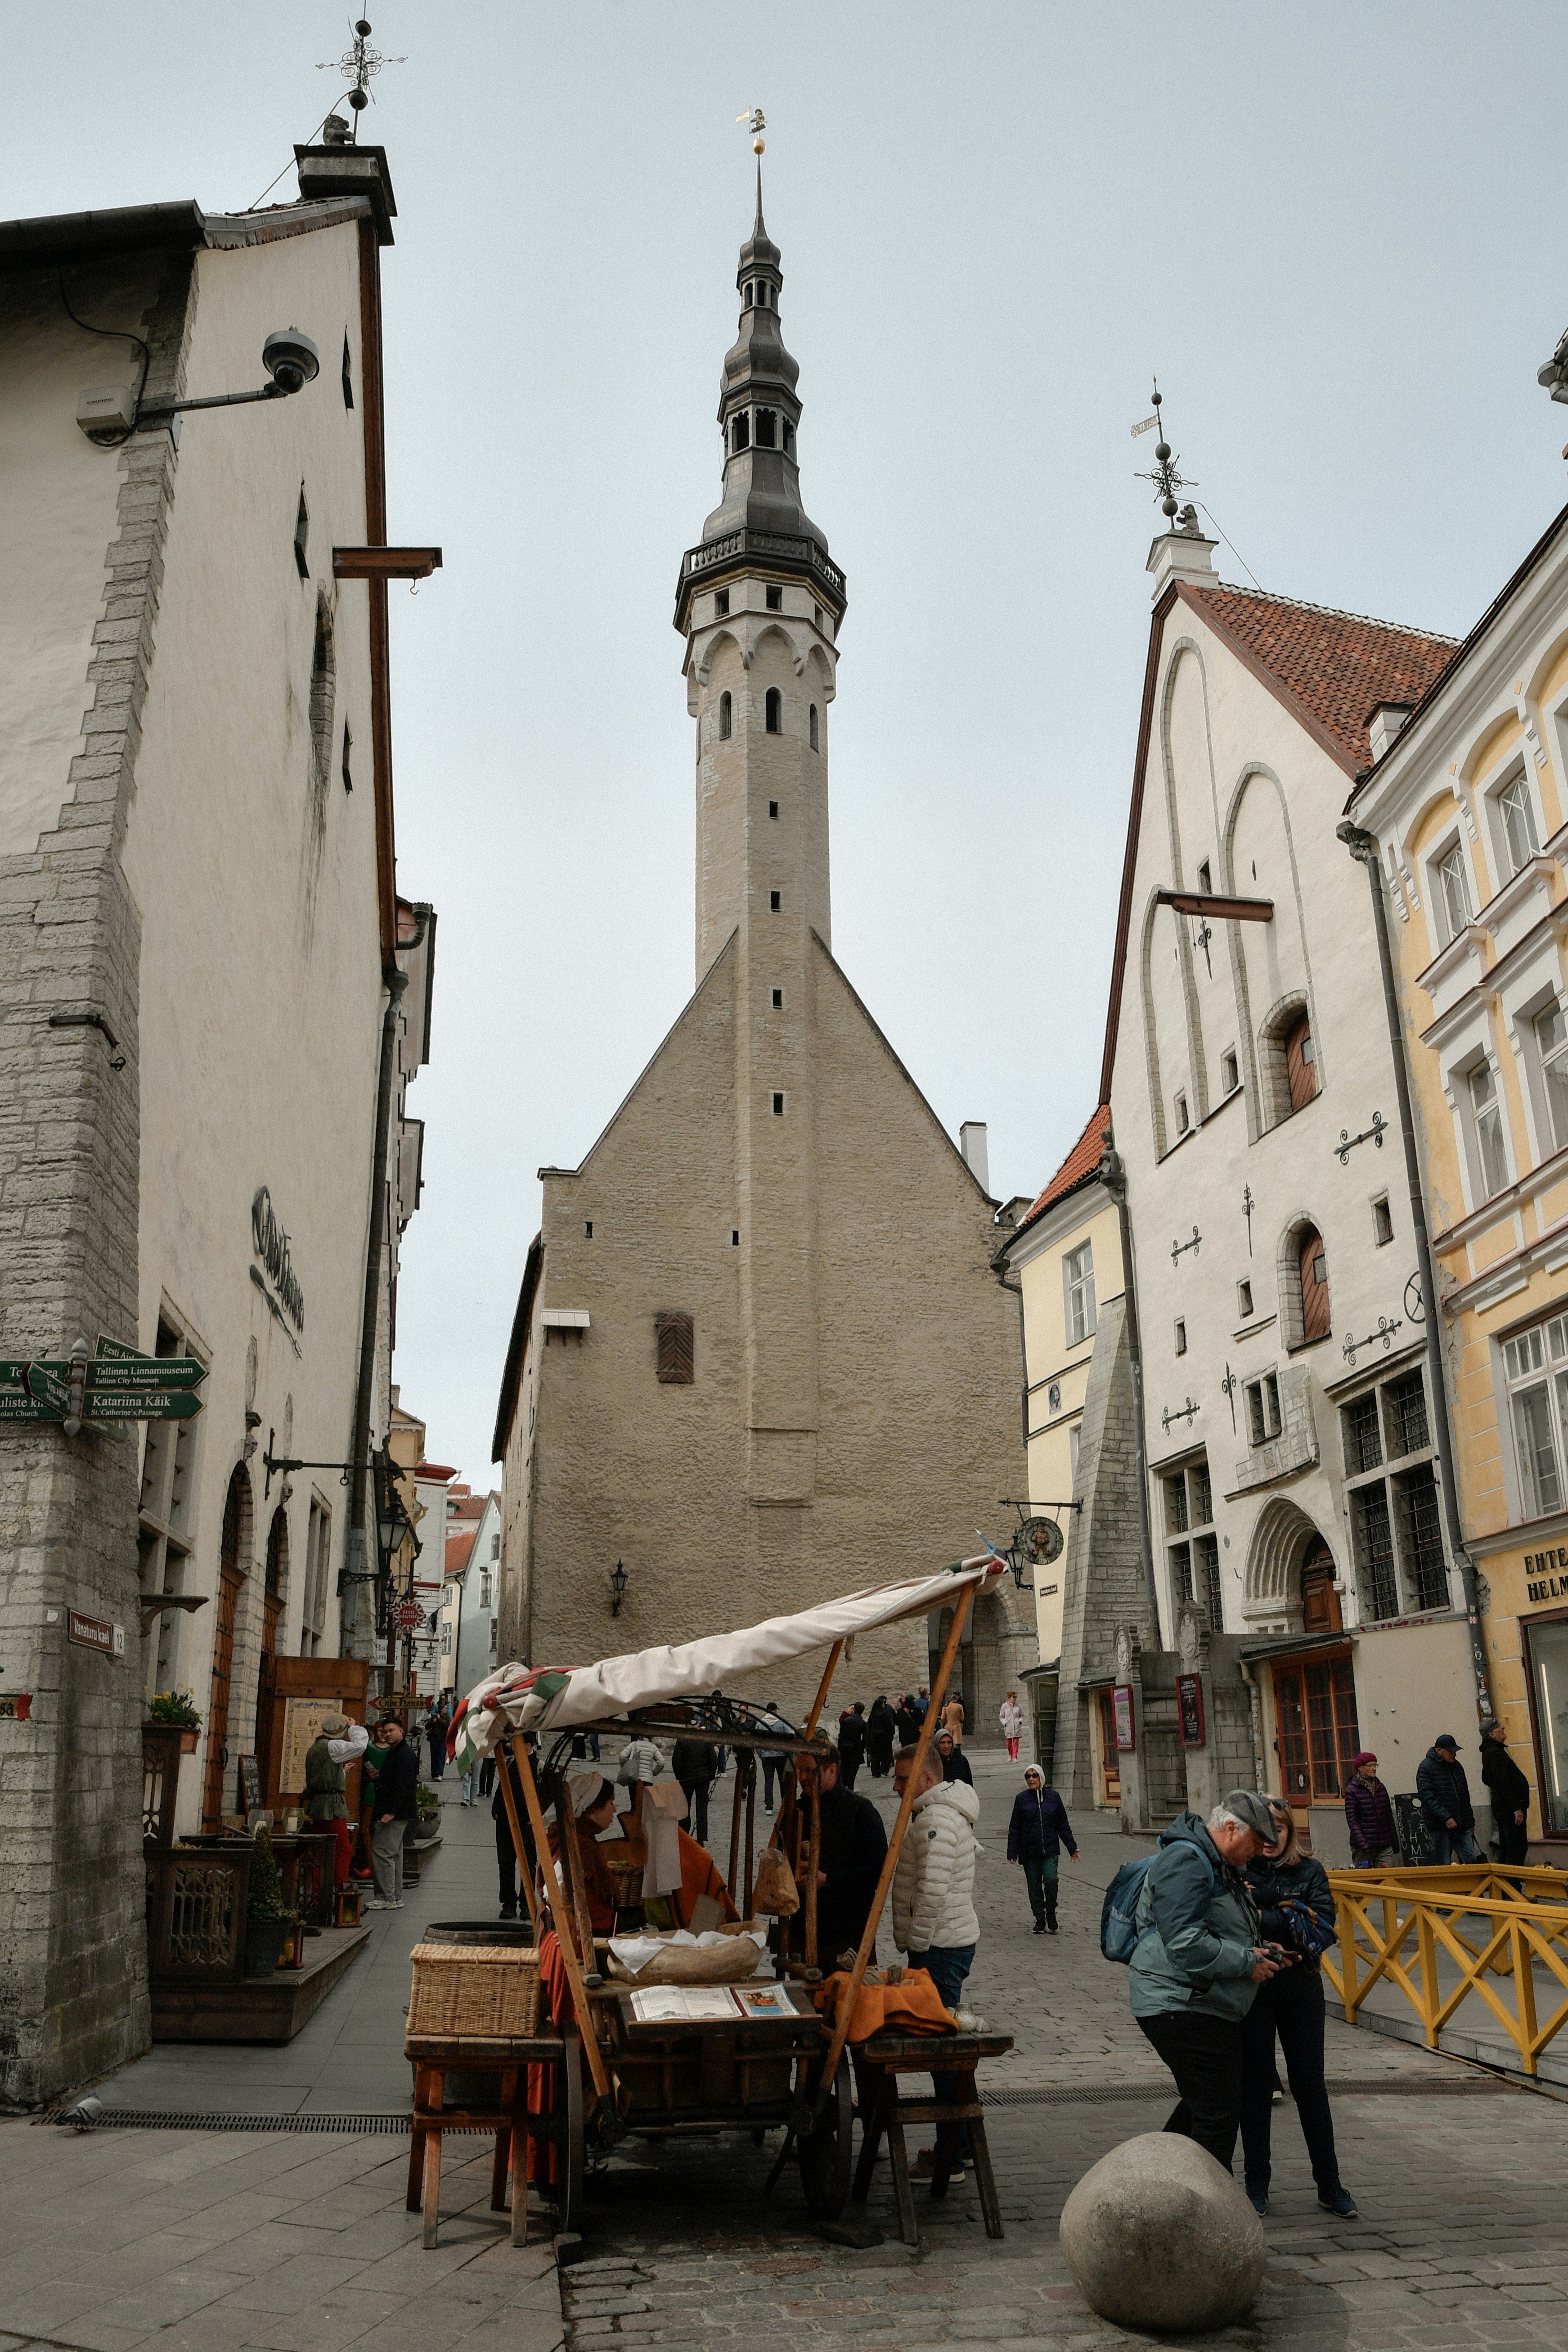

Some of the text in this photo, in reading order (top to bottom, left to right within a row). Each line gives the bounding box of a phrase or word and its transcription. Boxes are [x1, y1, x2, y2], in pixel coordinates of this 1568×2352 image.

[103, 1343, 120, 1357] Eesti
[96, 1366, 193, 1376] Tallinna Linnamuuseum
[47, 1379, 56, 1394] Viru
[92, 1395, 171, 1406] Katariina Käik
[138, 1408, 162, 1417] Passage
[74, 1619, 109, 1644] Vanaturu kael
[117, 1632, 123, 1649] 12
[398, 1699, 424, 1707] Hansa
